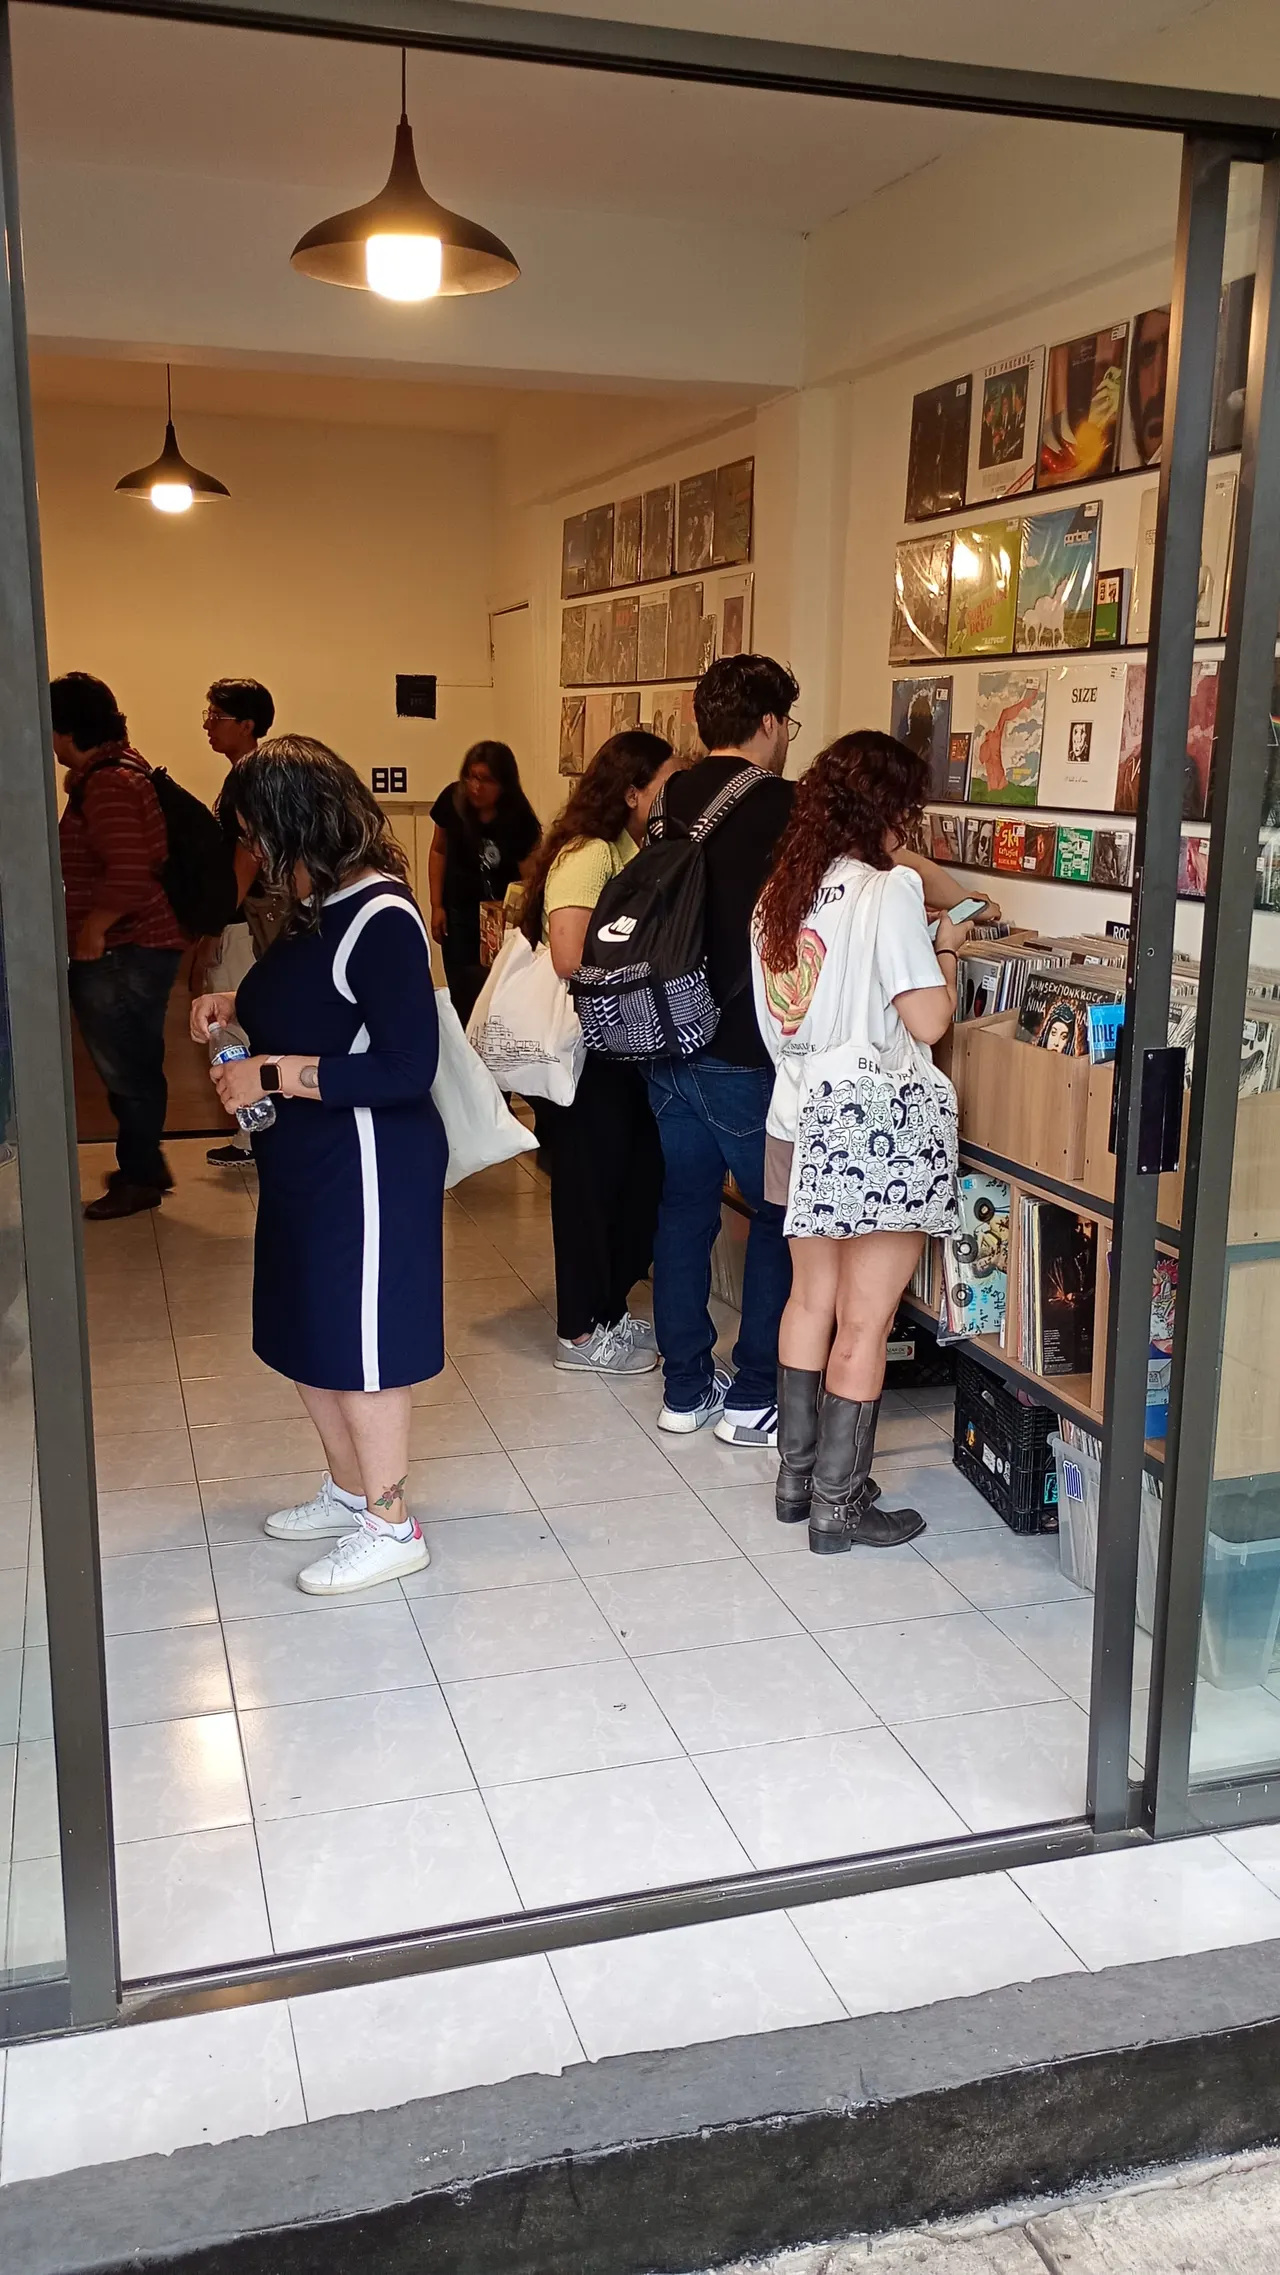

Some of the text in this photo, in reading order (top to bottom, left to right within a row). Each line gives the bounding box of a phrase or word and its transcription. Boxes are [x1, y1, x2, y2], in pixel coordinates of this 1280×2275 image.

[1071, 687, 1098, 703] SIZE
[1113, 925, 1131, 940] ROC
[1026, 997, 1047, 1016] NINA
[1092, 1023, 1115, 1042] IDLE
